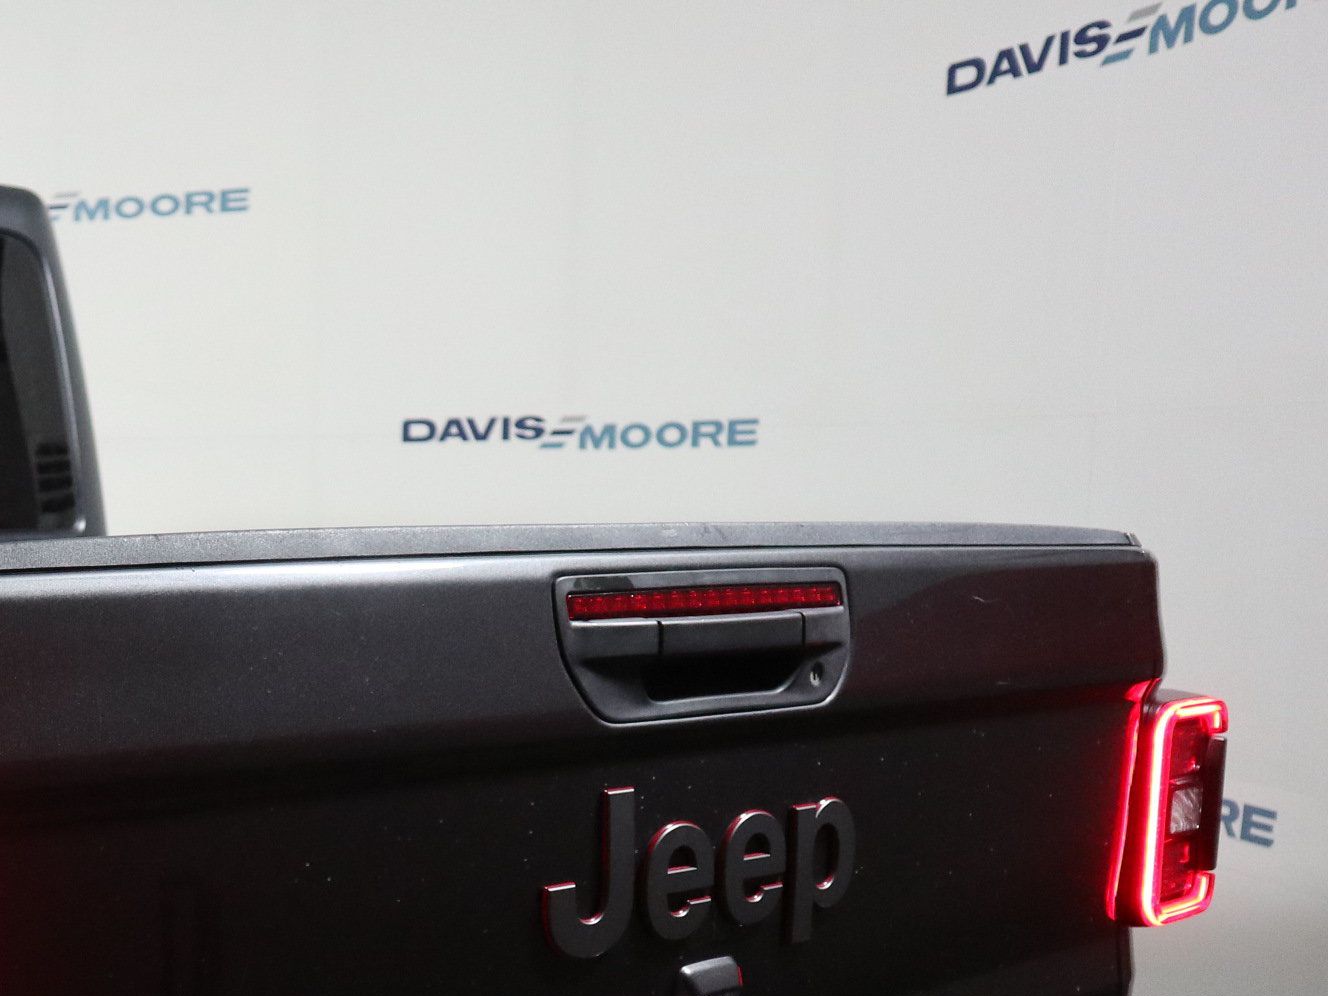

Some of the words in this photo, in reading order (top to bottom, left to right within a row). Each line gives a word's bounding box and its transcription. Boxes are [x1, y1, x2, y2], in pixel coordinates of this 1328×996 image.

[946, 20, 1112, 96] DAVIS
[74, 187, 251, 221] MOORE
[401, 415, 546, 443] DAVIS
[578, 418, 760, 450] MOORE
[542, 786, 857, 958] Jeep
